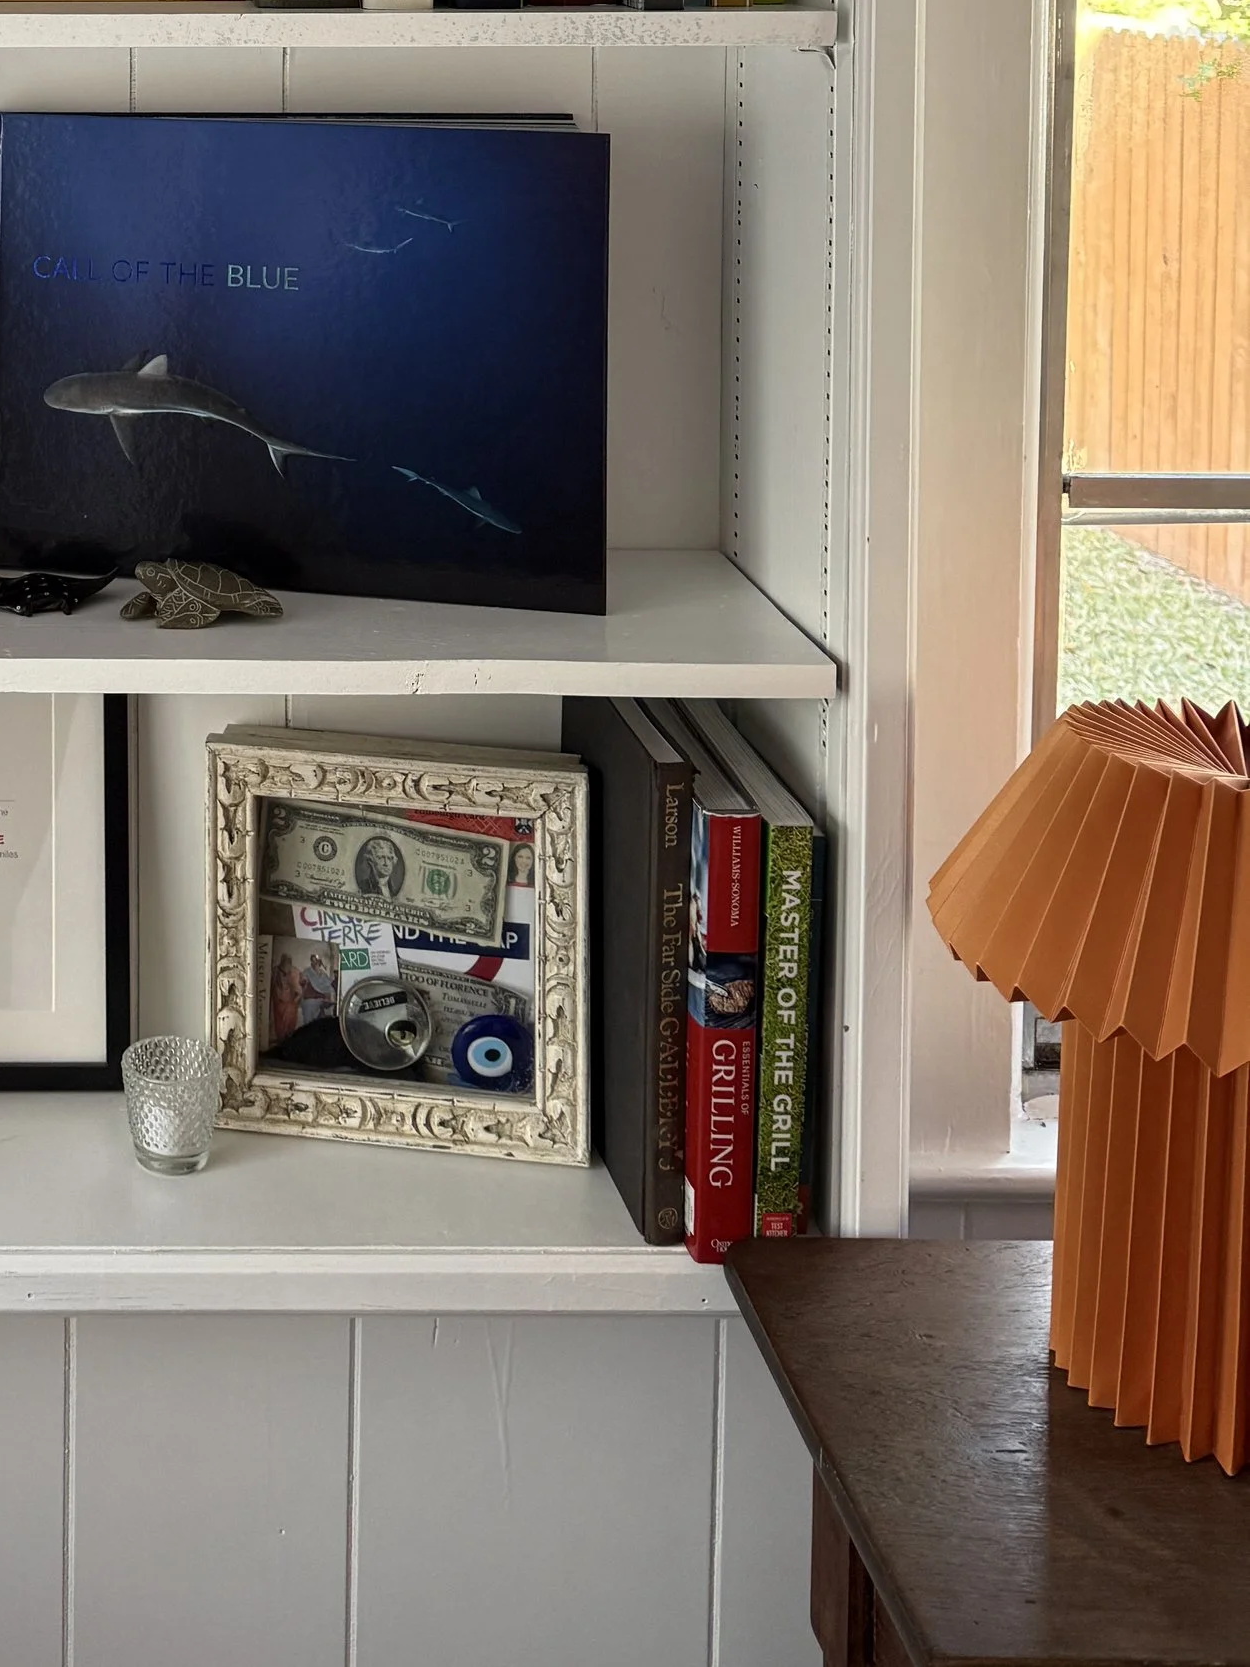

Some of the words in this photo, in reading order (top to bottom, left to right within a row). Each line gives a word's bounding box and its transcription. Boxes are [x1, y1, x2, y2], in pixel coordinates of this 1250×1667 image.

[33, 255, 101, 281] CALL
[112, 259, 150, 283] OF
[160, 262, 215, 287] THE
[227, 264, 300, 291] BLUE
[665, 783, 684, 848] Larson
[482, 846, 496, 866] 2
[312, 923, 383, 946] TERRE
[778, 870, 802, 979] MASTER
[426, 977, 439, 987] OF
[440, 980, 489, 997] FLORENCE
[777, 988, 797, 1025] OF
[774, 1036, 794, 1085] THE
[709, 1039, 737, 1189] GRILLING
[770, 1094, 792, 1172] GRILL
[771, 1222, 784, 1230] TEST
